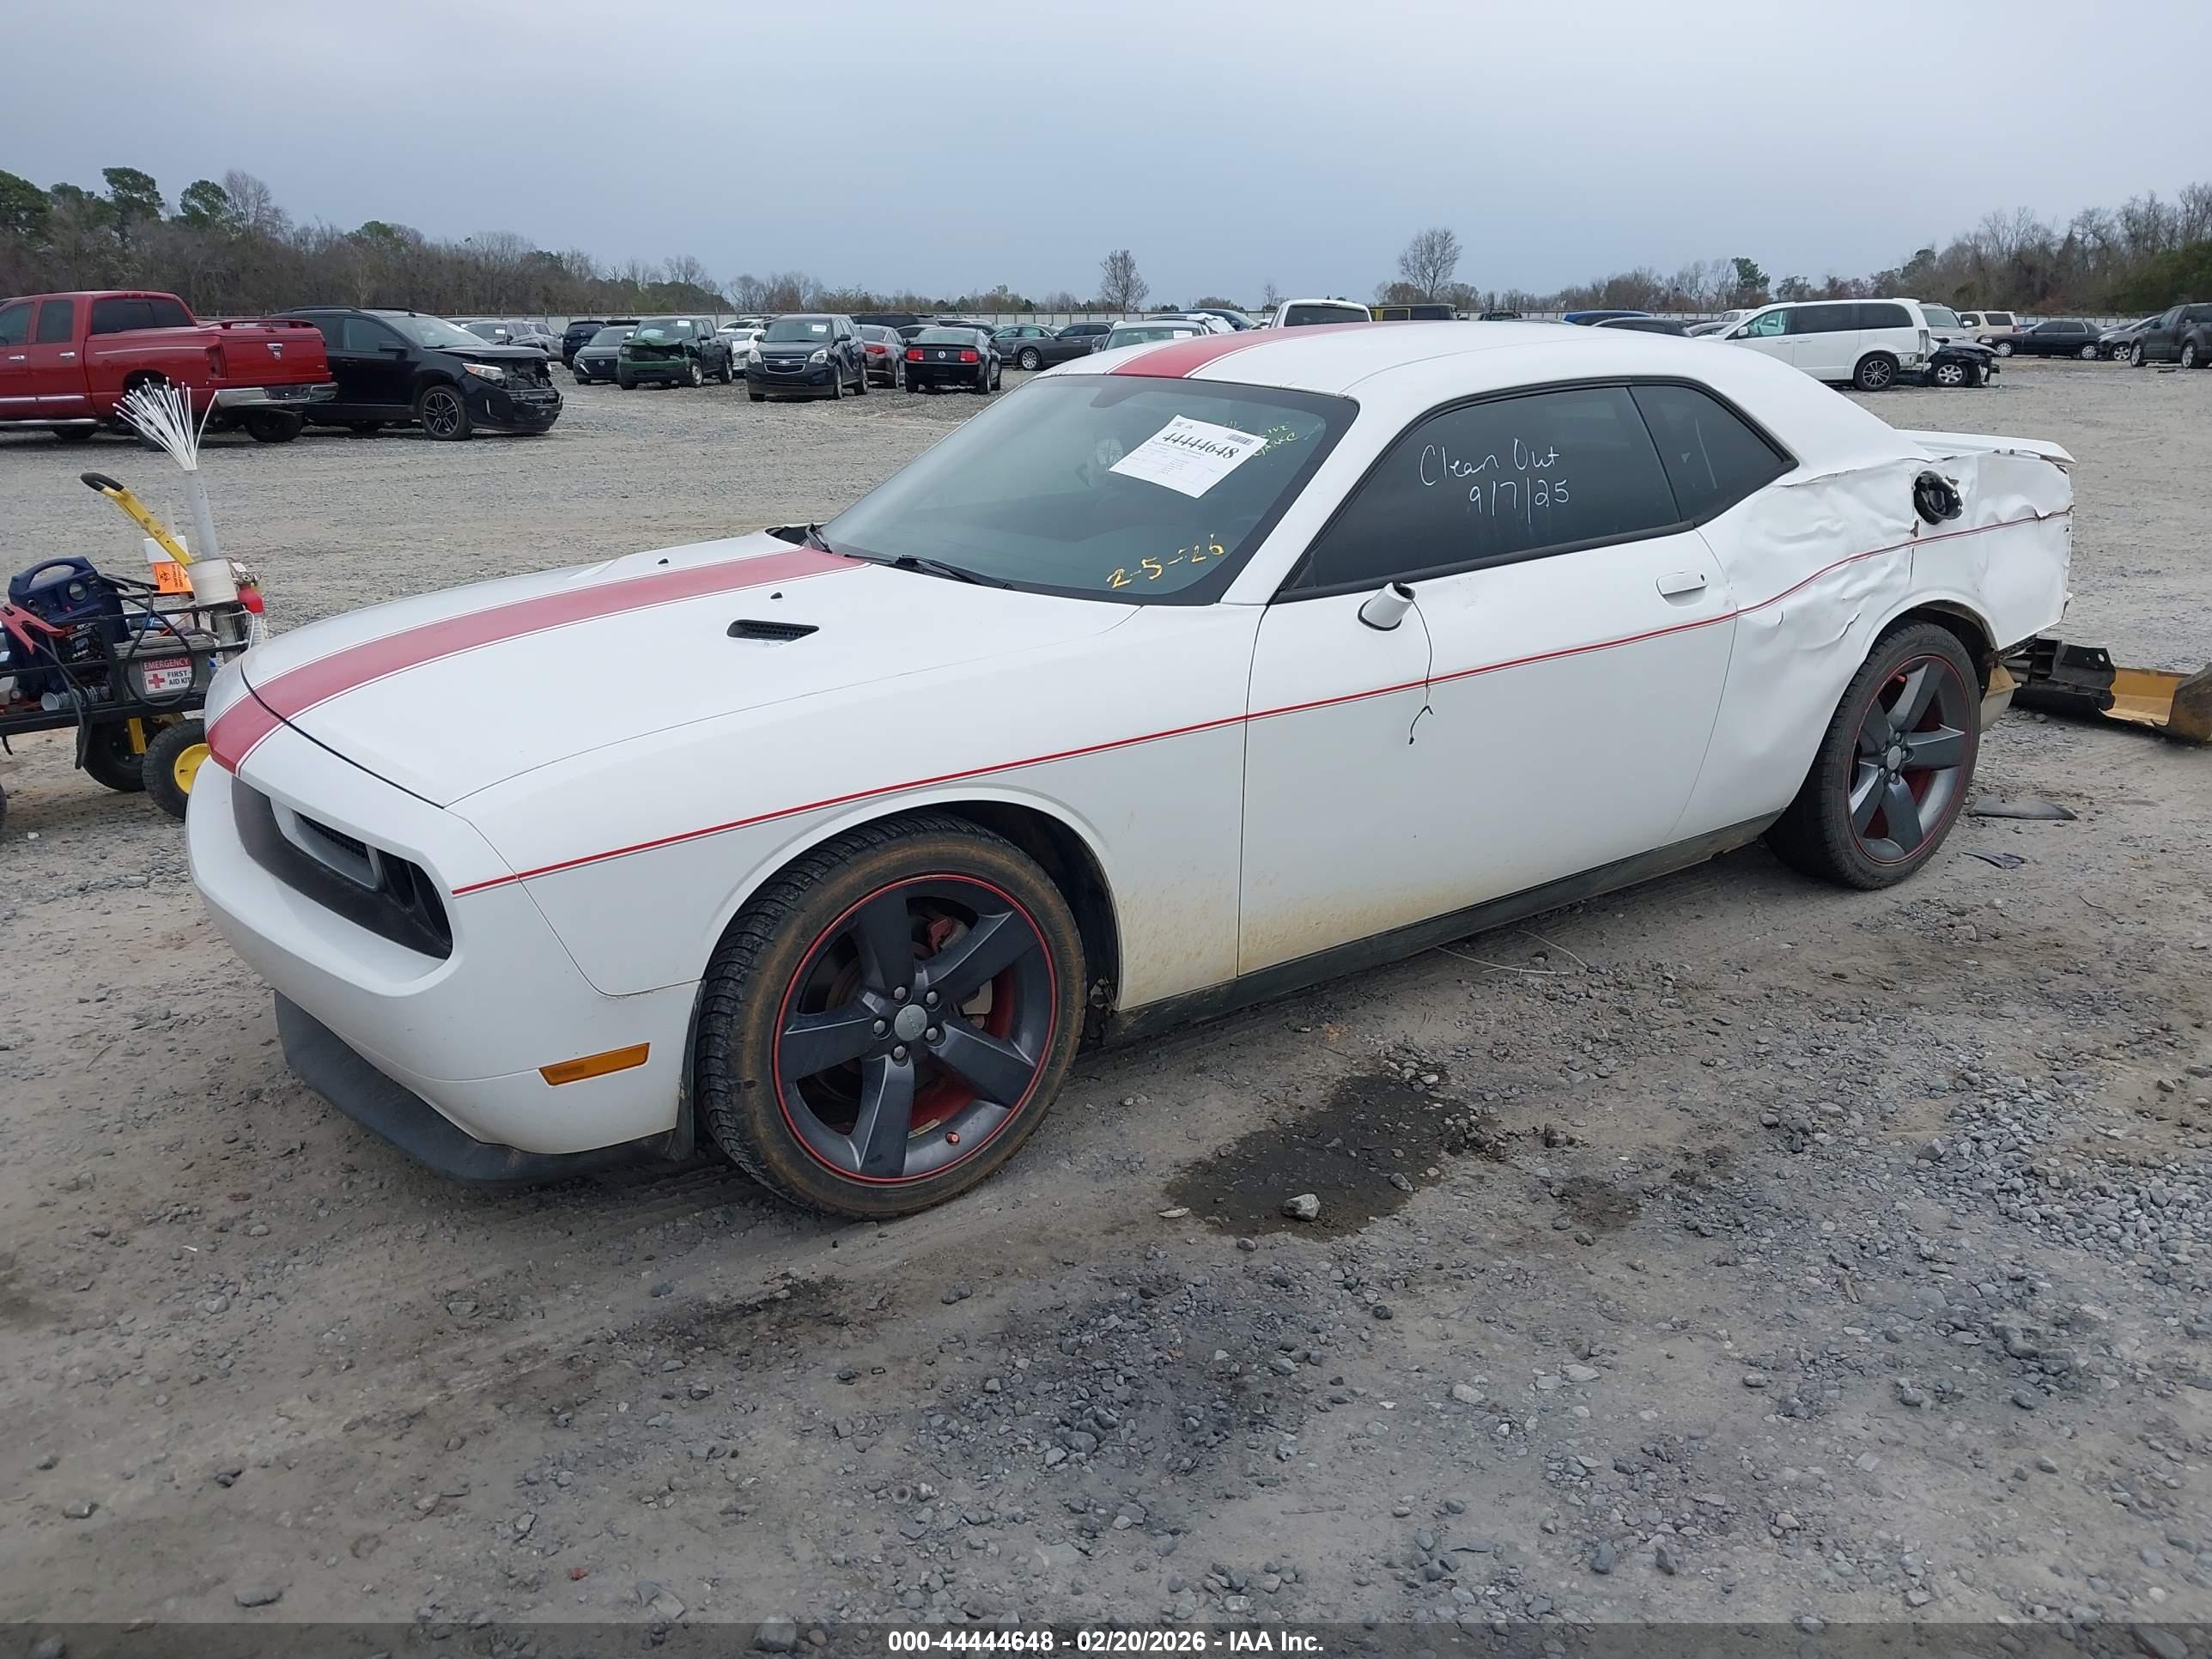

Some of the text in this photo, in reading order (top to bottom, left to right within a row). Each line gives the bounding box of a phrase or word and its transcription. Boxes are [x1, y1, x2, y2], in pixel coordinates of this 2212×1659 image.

[1162, 432, 1240, 459] 44444648
[1419, 438, 1560, 486] Clean Out
[1469, 477, 1569, 525] 9/7/25
[143, 658, 189, 670] EMERGENCY
